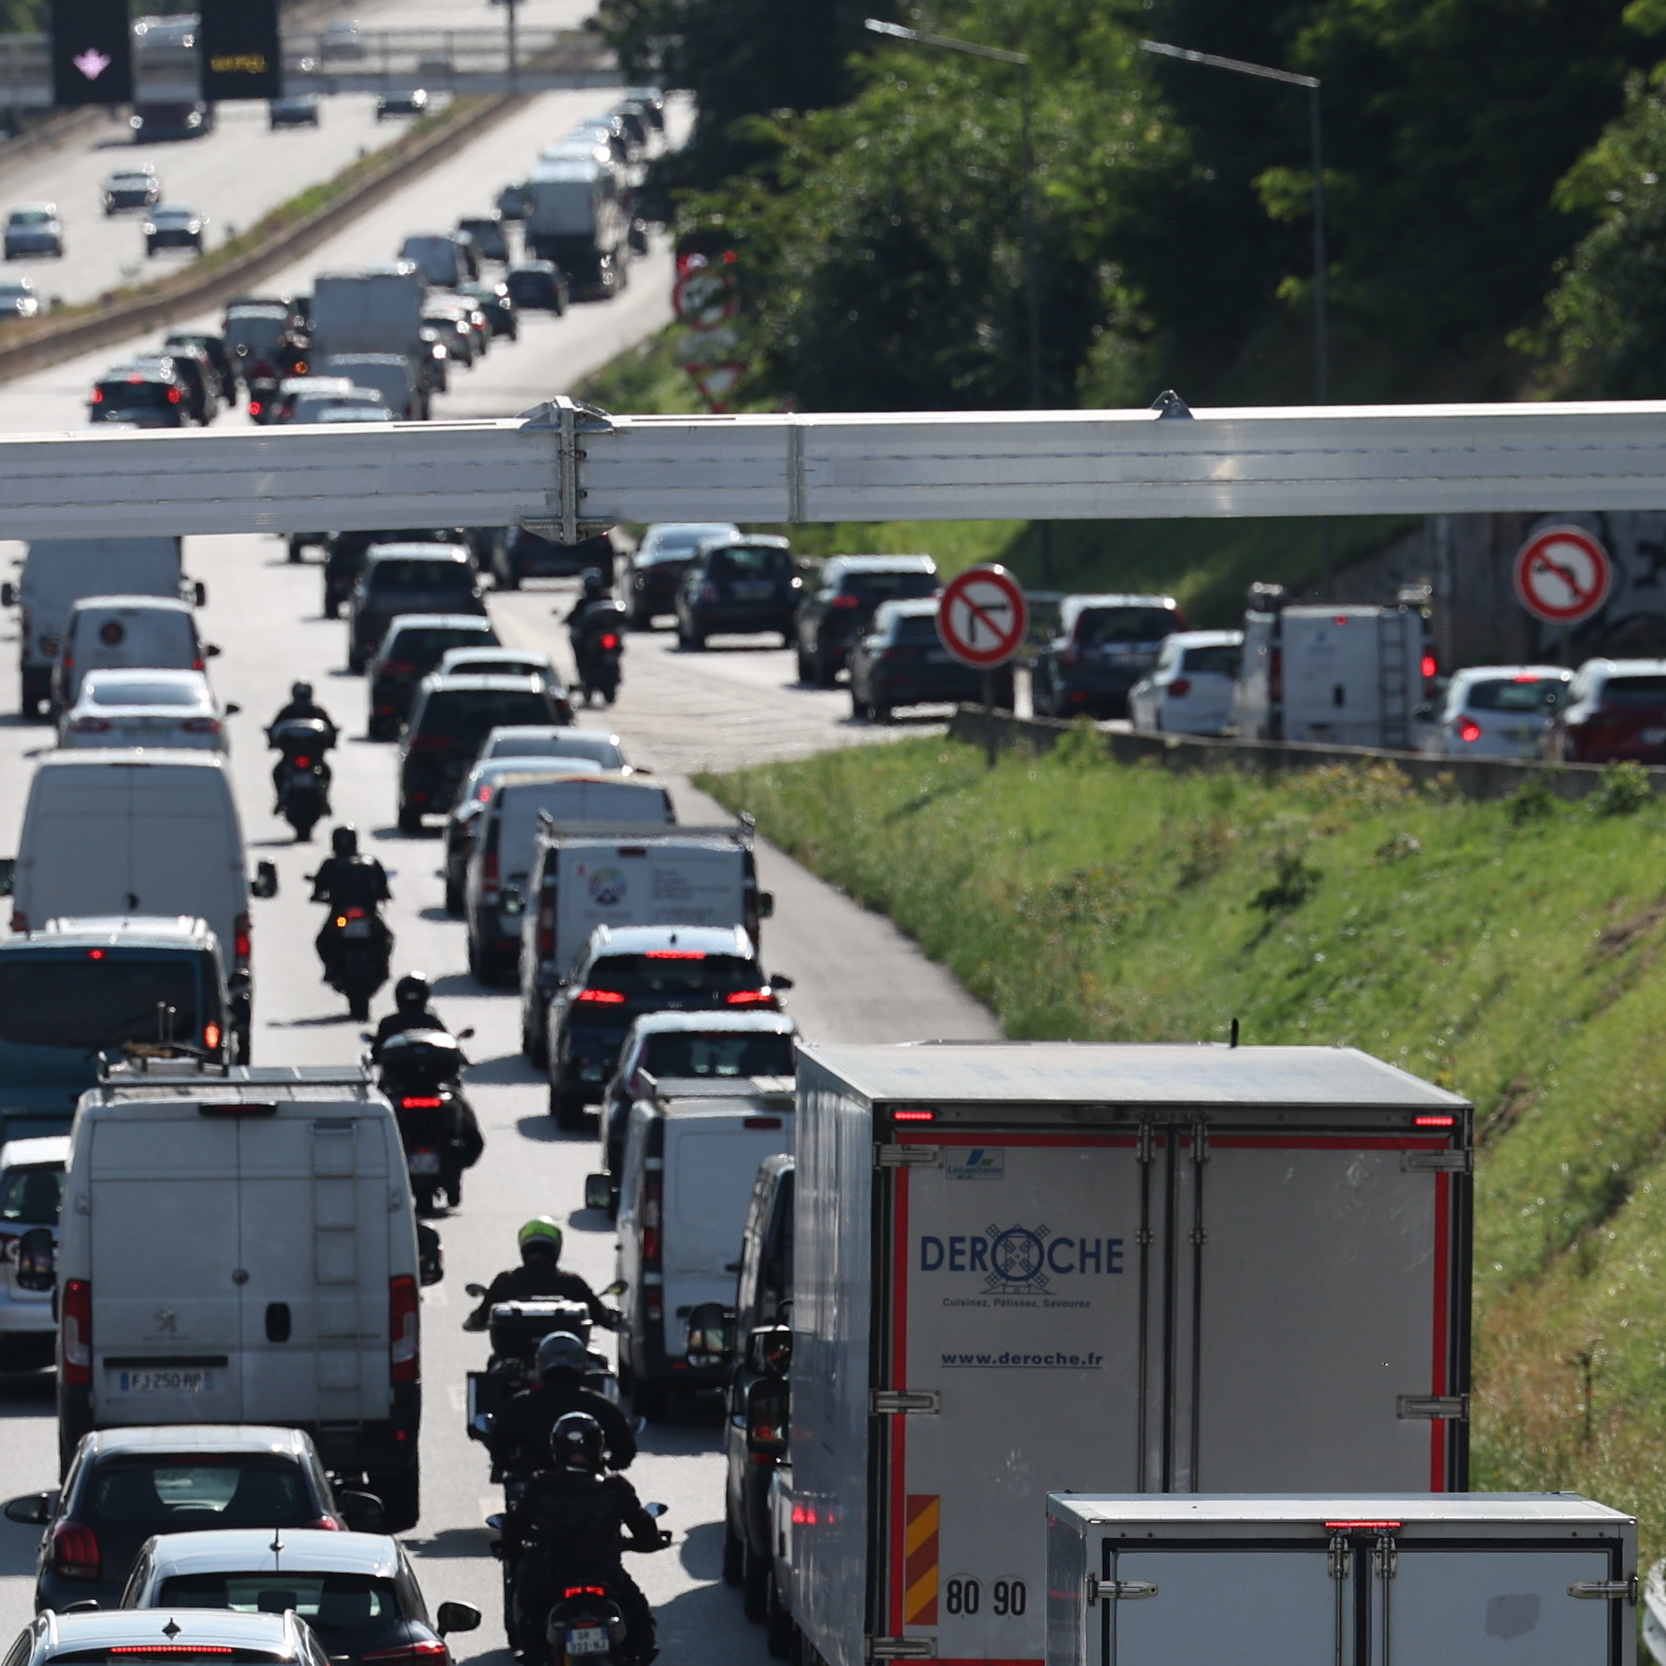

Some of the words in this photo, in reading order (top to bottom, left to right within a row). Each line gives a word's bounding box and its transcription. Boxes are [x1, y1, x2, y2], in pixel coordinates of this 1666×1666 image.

[921, 1228, 1124, 1281] DEROCHE
[942, 1298, 991, 1308] Cuisinez,
[1043, 1298, 1091, 1308] Savourez
[941, 1352, 1103, 1366] www.deroche.fr
[946, 1579, 980, 1615] 80
[993, 1580, 1027, 1616] 90
